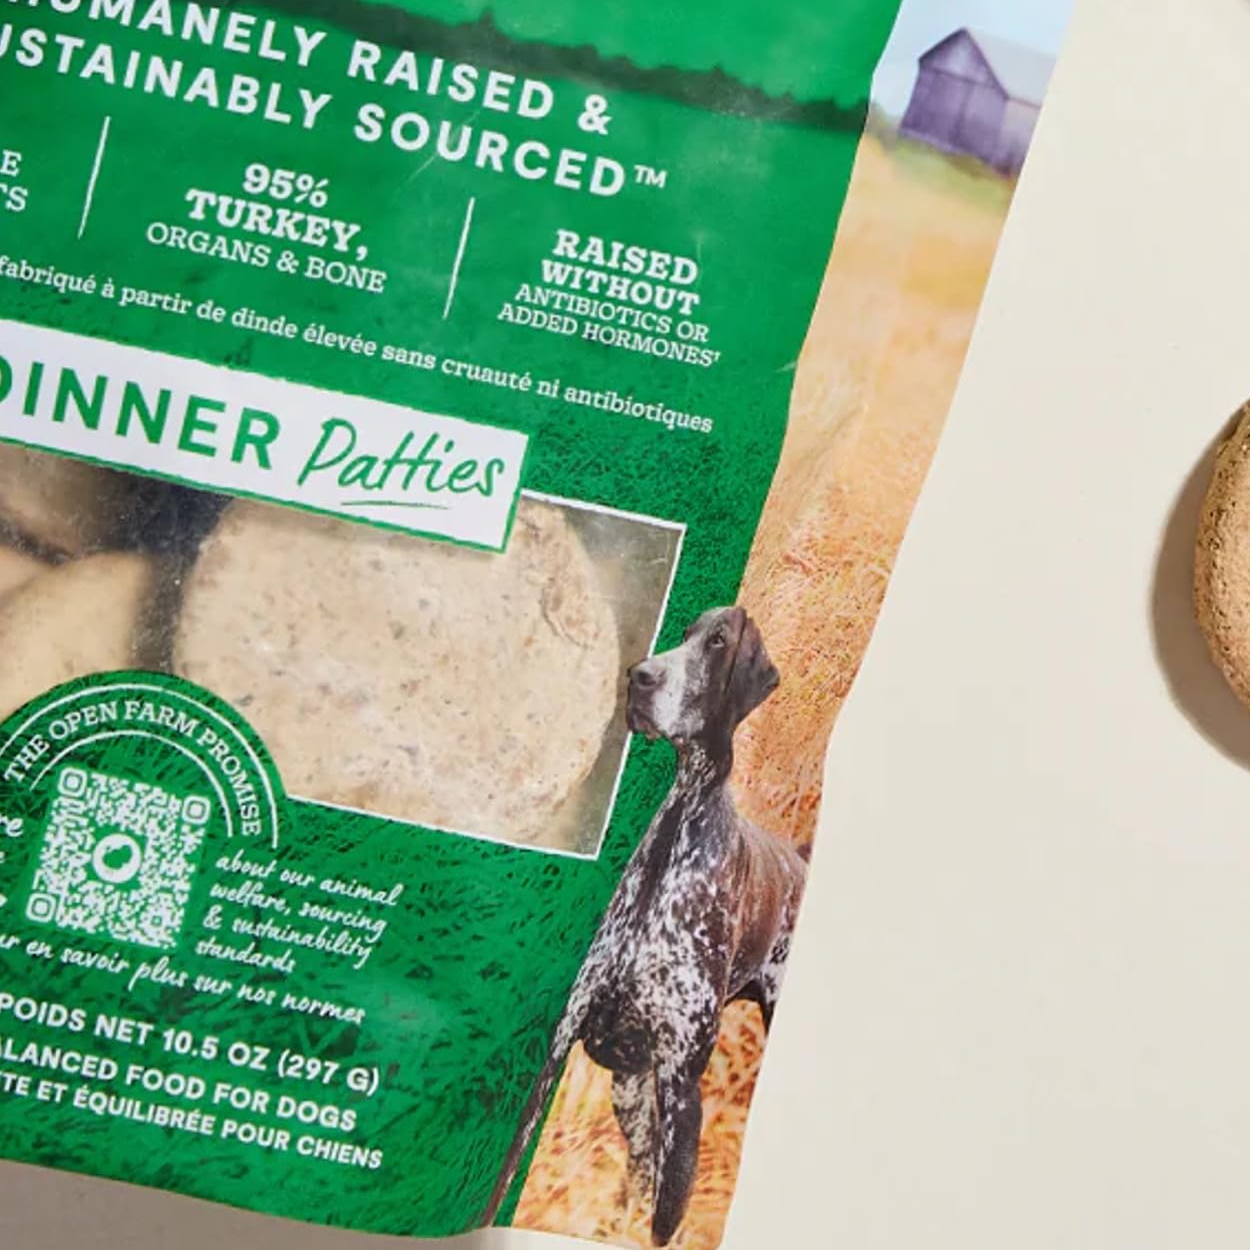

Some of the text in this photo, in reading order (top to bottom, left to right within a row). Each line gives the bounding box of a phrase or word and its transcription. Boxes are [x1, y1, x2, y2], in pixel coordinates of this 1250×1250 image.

[347, 40, 554, 120] RAISED
[577, 94, 612, 135] &
[243, 163, 328, 208] 95%
[147, 222, 387, 293] ORGANS & BONE
[186, 188, 367, 261] TURKEY,
[553, 229, 699, 286] RAISED
[498, 304, 578, 335] ADDED
[515, 284, 709, 343] ANTIBIOTICS OR
[541, 259, 699, 316] WITHOUT
[101, 277, 115, 298] à
[119, 284, 192, 314] partir
[196, 294, 226, 323] de
[231, 307, 298, 339] dinde
[303, 320, 377, 357] élevée
[381, 344, 436, 371] sans
[441, 357, 532, 392] cruauté
[536, 379, 560, 399] ni
[564, 385, 713, 434] antibiotiques
[297, 417, 504, 497] Patties
[3, 701, 261, 836] THE OPEN FARM PROMISE
[210, 880, 387, 943] welfare, sourcing
[216, 849, 404, 906] about our animal
[195, 936, 295, 973] standards
[203, 904, 373, 970] & sustainability
[26, 940, 54, 958] en
[61, 947, 129, 973] savoir
[127, 956, 188, 991] plus
[193, 975, 232, 994] sur
[236, 983, 276, 1005] nos
[281, 993, 365, 1024] normes
[0, 992, 379, 1097] POIDS NET 10.5 OZ (297 G)
[0, 1035, 357, 1132] LANCED FOOD FOR DOGS
[36, 1080, 68, 1103] ET
[73, 1084, 216, 1136] ÉQUILIBRÉE
[220, 1122, 290, 1151] POUR
[296, 1135, 383, 1170] CHIENS
